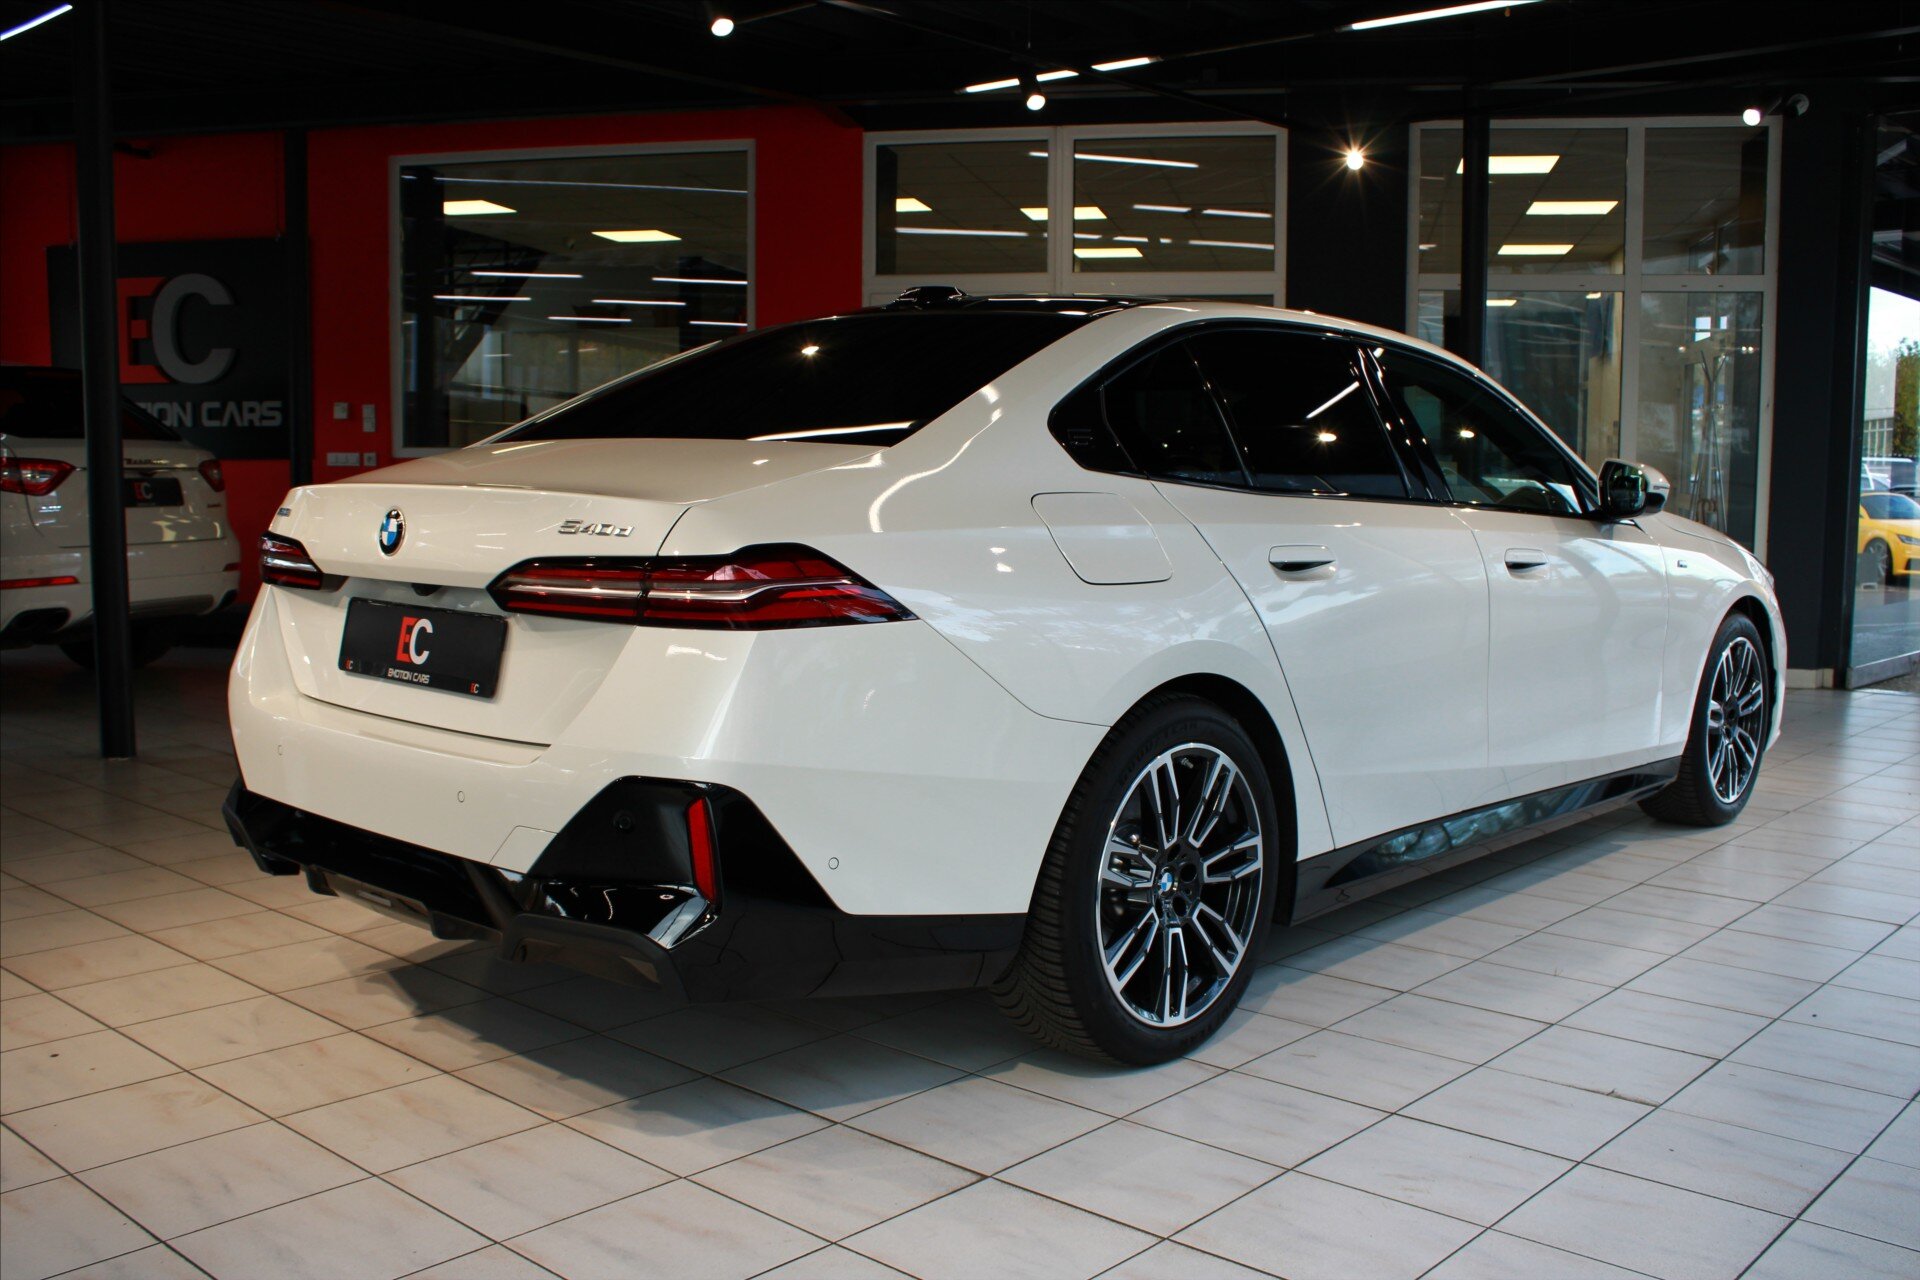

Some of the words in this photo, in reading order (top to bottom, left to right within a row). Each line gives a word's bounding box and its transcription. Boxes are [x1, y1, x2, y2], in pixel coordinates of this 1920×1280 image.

[116, 273, 236, 384] EC
[201, 400, 283, 428] CARS
[558, 518, 635, 538] 540d
[396, 615, 433, 665] EC
[387, 667, 413, 681] EMOTION
[412, 670, 430, 685] CARS
